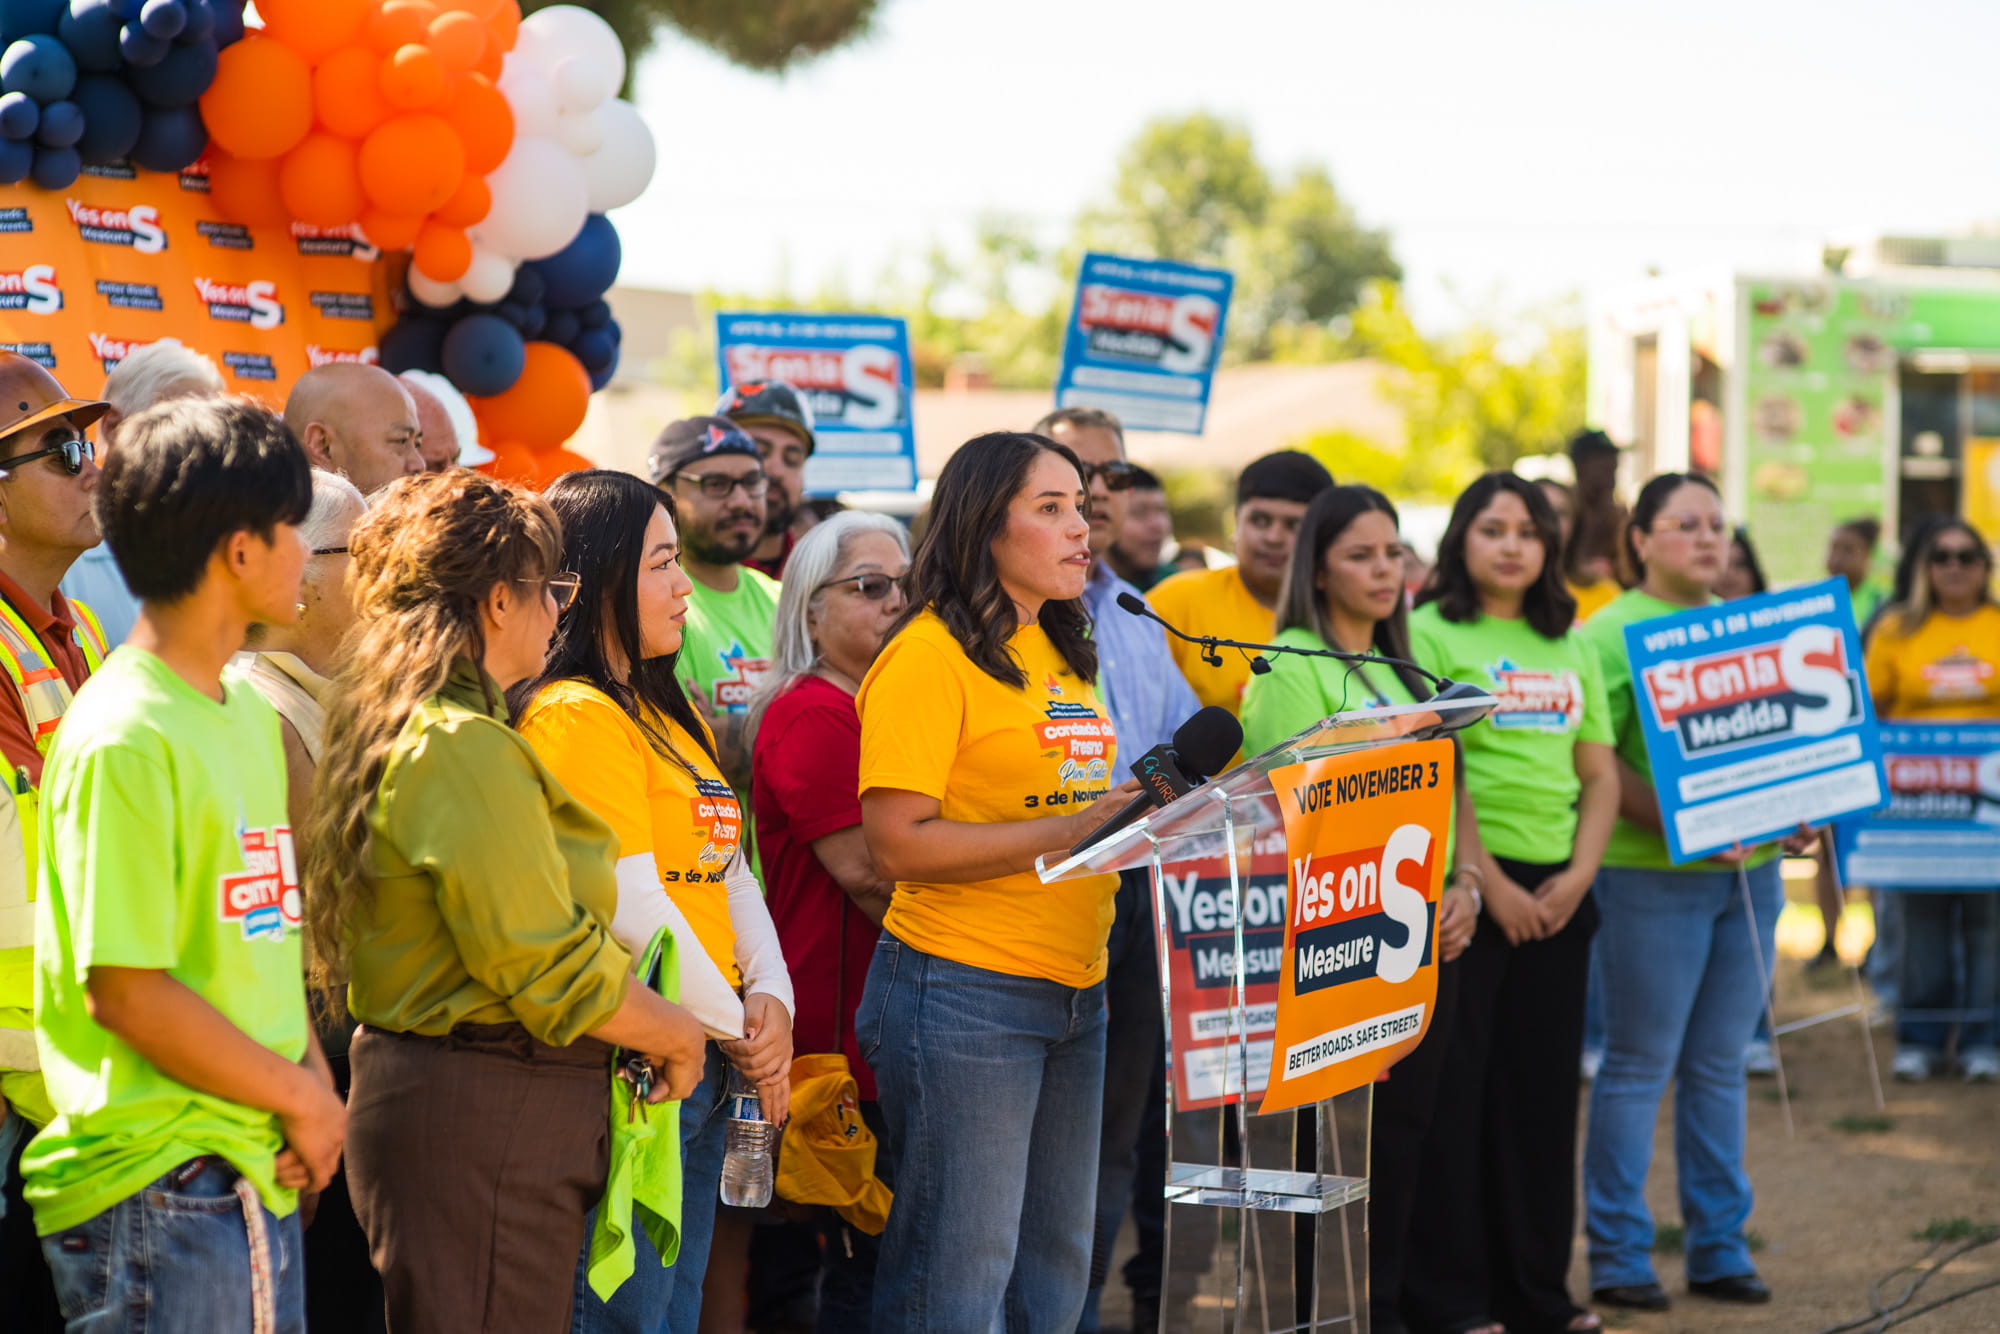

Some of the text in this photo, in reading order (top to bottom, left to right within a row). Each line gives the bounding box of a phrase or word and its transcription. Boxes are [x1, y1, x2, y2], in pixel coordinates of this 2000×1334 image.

[66, 198, 128, 228] Yes on
[82, 227, 131, 243] Measure
[128, 205, 164, 254] S
[22, 264, 60, 315] S
[194, 277, 248, 304] Yes on
[247, 280, 281, 330] S
[88, 332, 126, 360] Yes
[1163, 294, 1216, 375] S
[843, 344, 899, 428] S
[1699, 662, 1745, 700] en
[1743, 652, 1779, 690] la
[1780, 624, 1852, 737] S
[1044, 722, 1101, 740] Condado
[1070, 739, 1104, 756] Fresno
[1688, 699, 1788, 748] Medida
[698, 802, 737, 819] Condado
[1024, 794, 1040, 808] 3
[1045, 790, 1069, 806] de
[1150, 773, 1178, 804] WIRE
[1293, 761, 1439, 815] VOTE NOVEMBER 3
[665, 870, 680, 882] 3
[685, 869, 702, 883] de
[1293, 853, 1377, 928] Yes on
[1163, 871, 1234, 933] Yes
[1376, 824, 1432, 984] S
[1298, 934, 1374, 983] Measure
[1289, 1045, 1321, 1071] BETTER
[1323, 1033, 1355, 1058] ROADS.
[1356, 1025, 1378, 1047] SAFE
[1381, 1013, 1419, 1039] STREETS.
